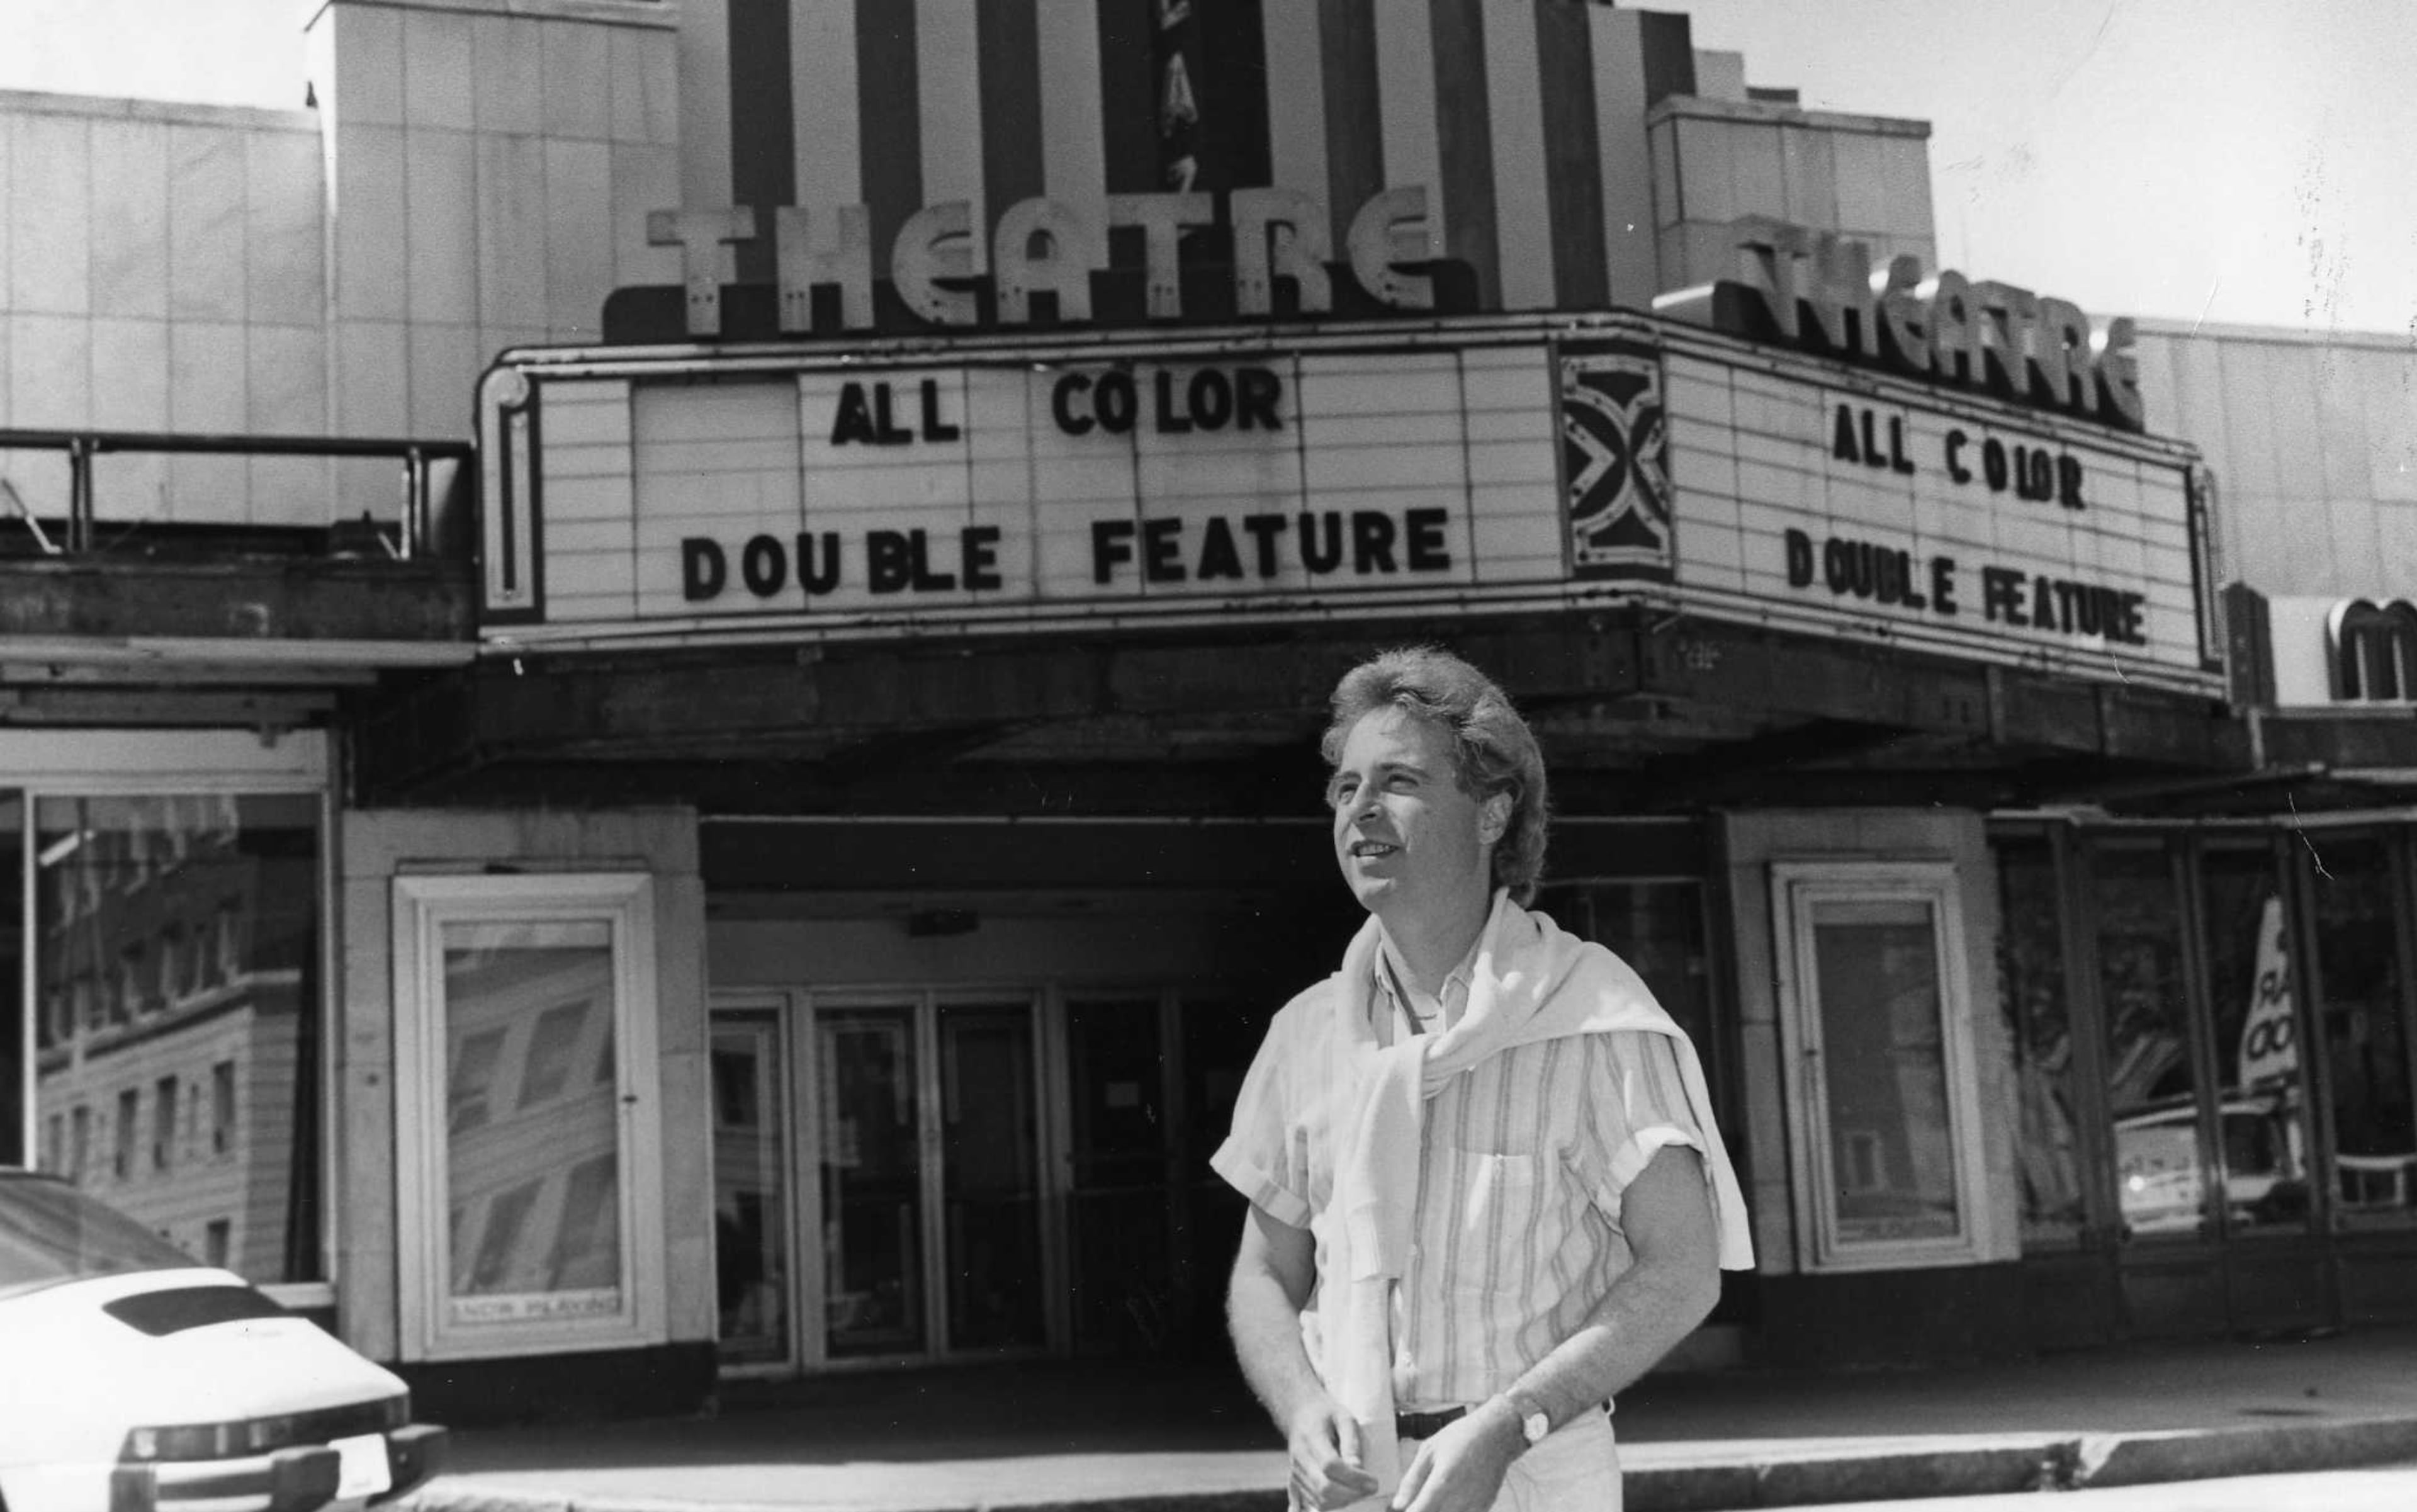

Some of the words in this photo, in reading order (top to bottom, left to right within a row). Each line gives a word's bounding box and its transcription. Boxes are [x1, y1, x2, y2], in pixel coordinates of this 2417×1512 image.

[647, 185, 1446, 337] THEATRE
[830, 380, 960, 445] ALL
[1052, 368, 1283, 436] COLOR
[1832, 403, 1915, 474] ALL
[1945, 429, 2086, 510] COLOR
[681, 525, 1002, 601] DOUBLE
[1091, 509, 1451, 585] FEATURE
[1785, 527, 1957, 615] DOUBLE
[1981, 565, 2146, 646] FEATURE
